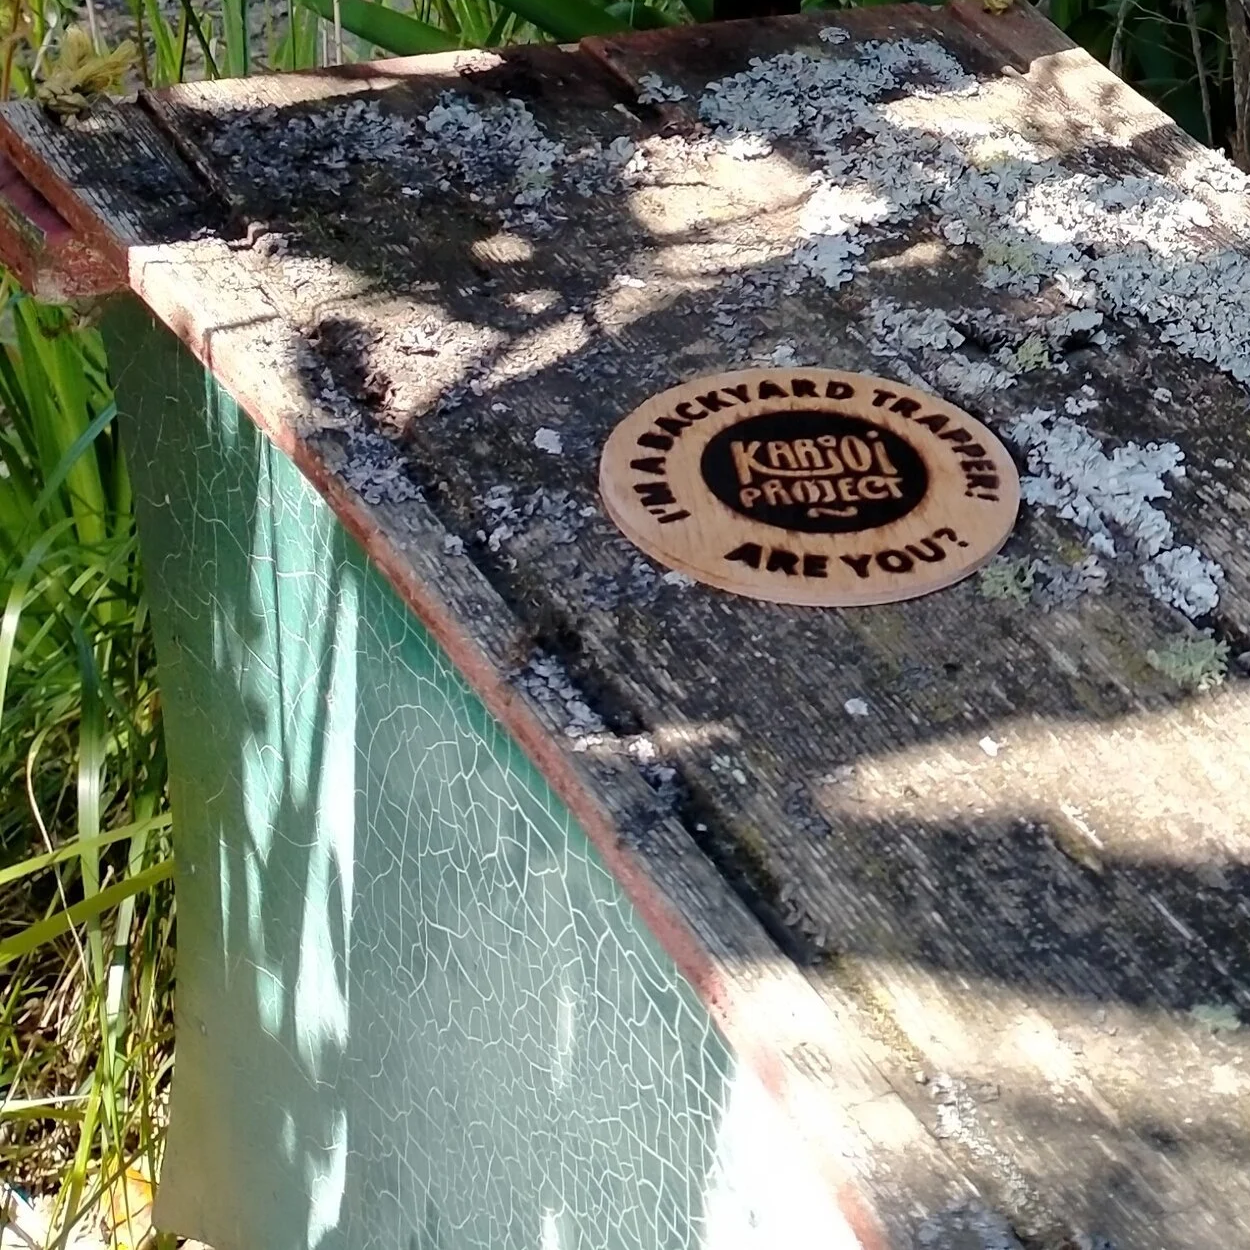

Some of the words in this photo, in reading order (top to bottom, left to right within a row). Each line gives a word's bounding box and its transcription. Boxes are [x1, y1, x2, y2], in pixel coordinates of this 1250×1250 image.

[638, 379, 854, 451] BACKYARD
[630, 456, 666, 475] A
[872, 389, 1000, 502] TRAPPER!
[633, 483, 691, 524] I'M
[739, 476, 905, 508] PROJECT
[724, 542, 828, 578] ARE
[839, 527, 969, 579] YOU?
